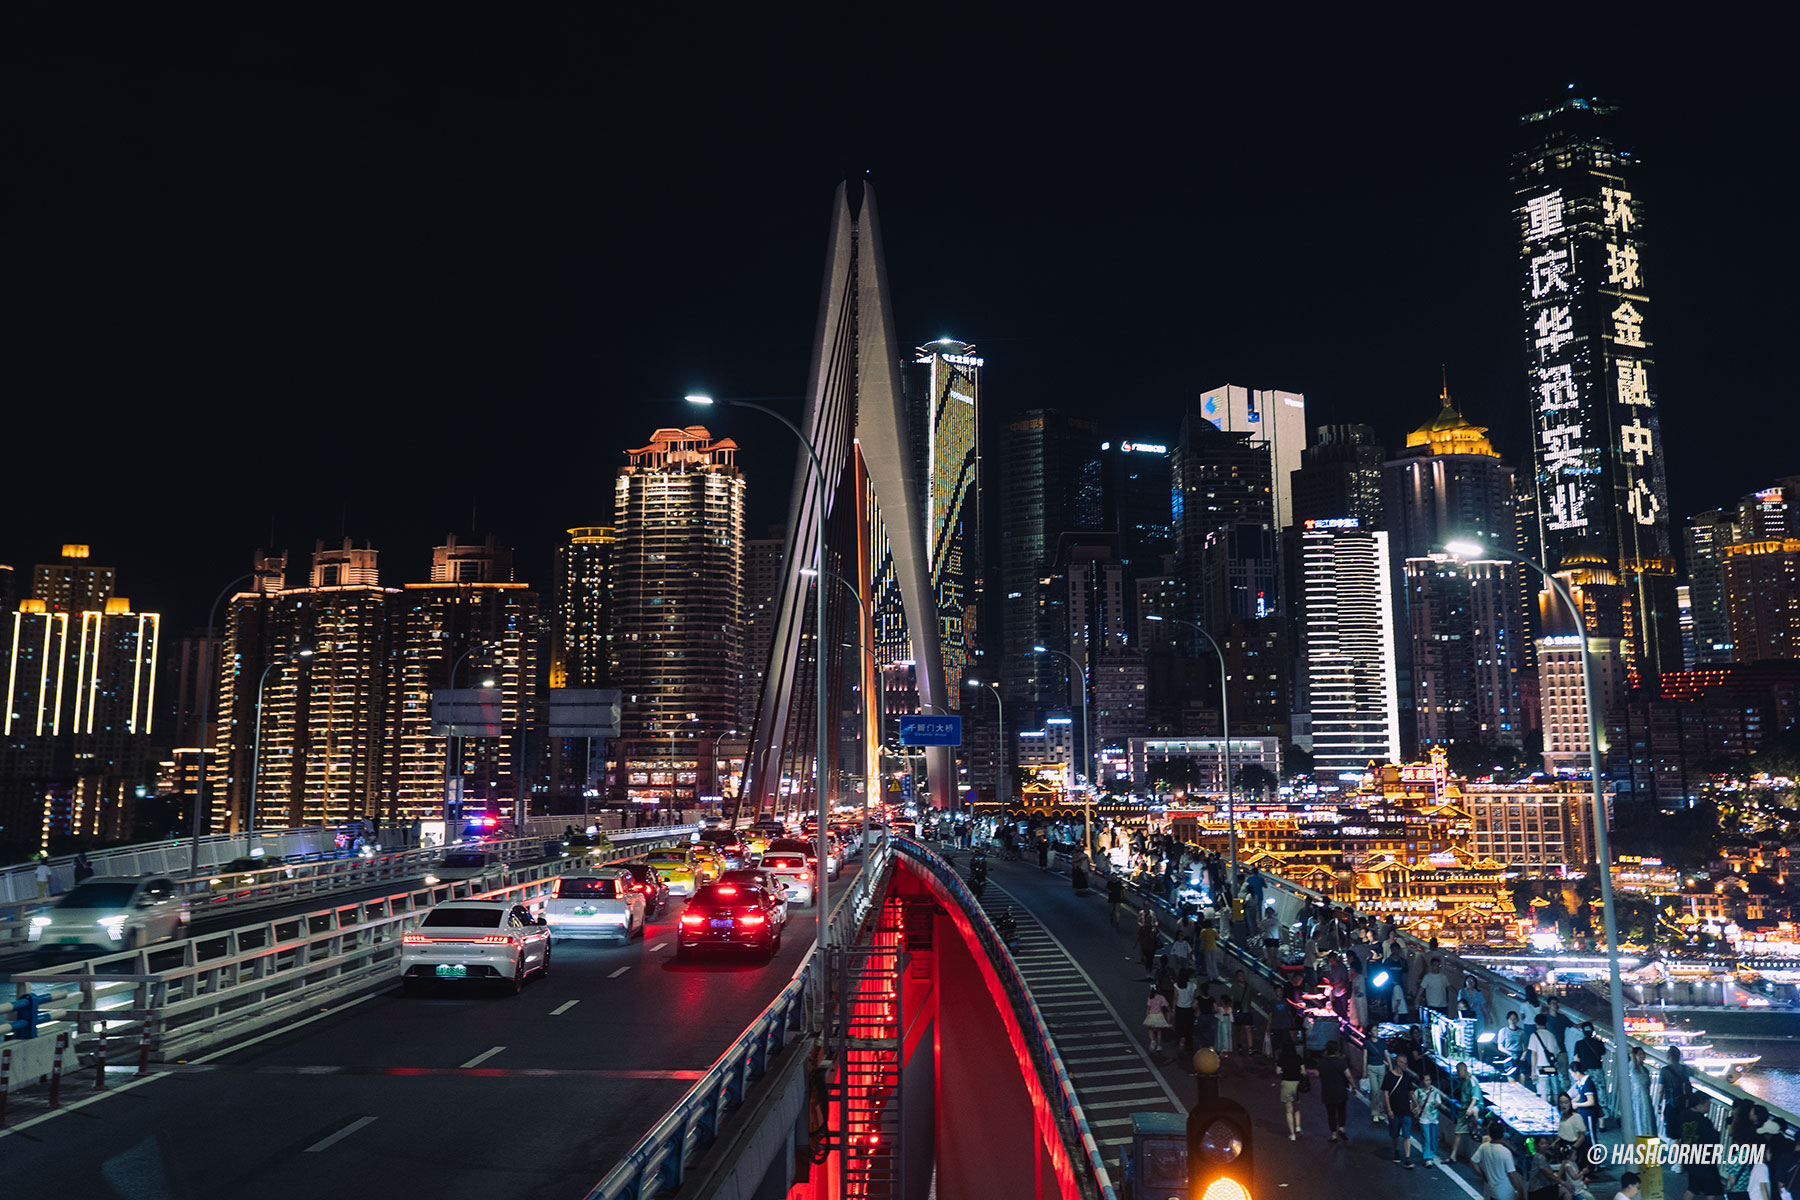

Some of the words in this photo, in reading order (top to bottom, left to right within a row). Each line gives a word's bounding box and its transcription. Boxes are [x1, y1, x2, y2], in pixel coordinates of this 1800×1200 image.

[1525, 187, 1588, 531] 重庆华迅实业
[1601, 186, 1660, 525] 环球金融中心
